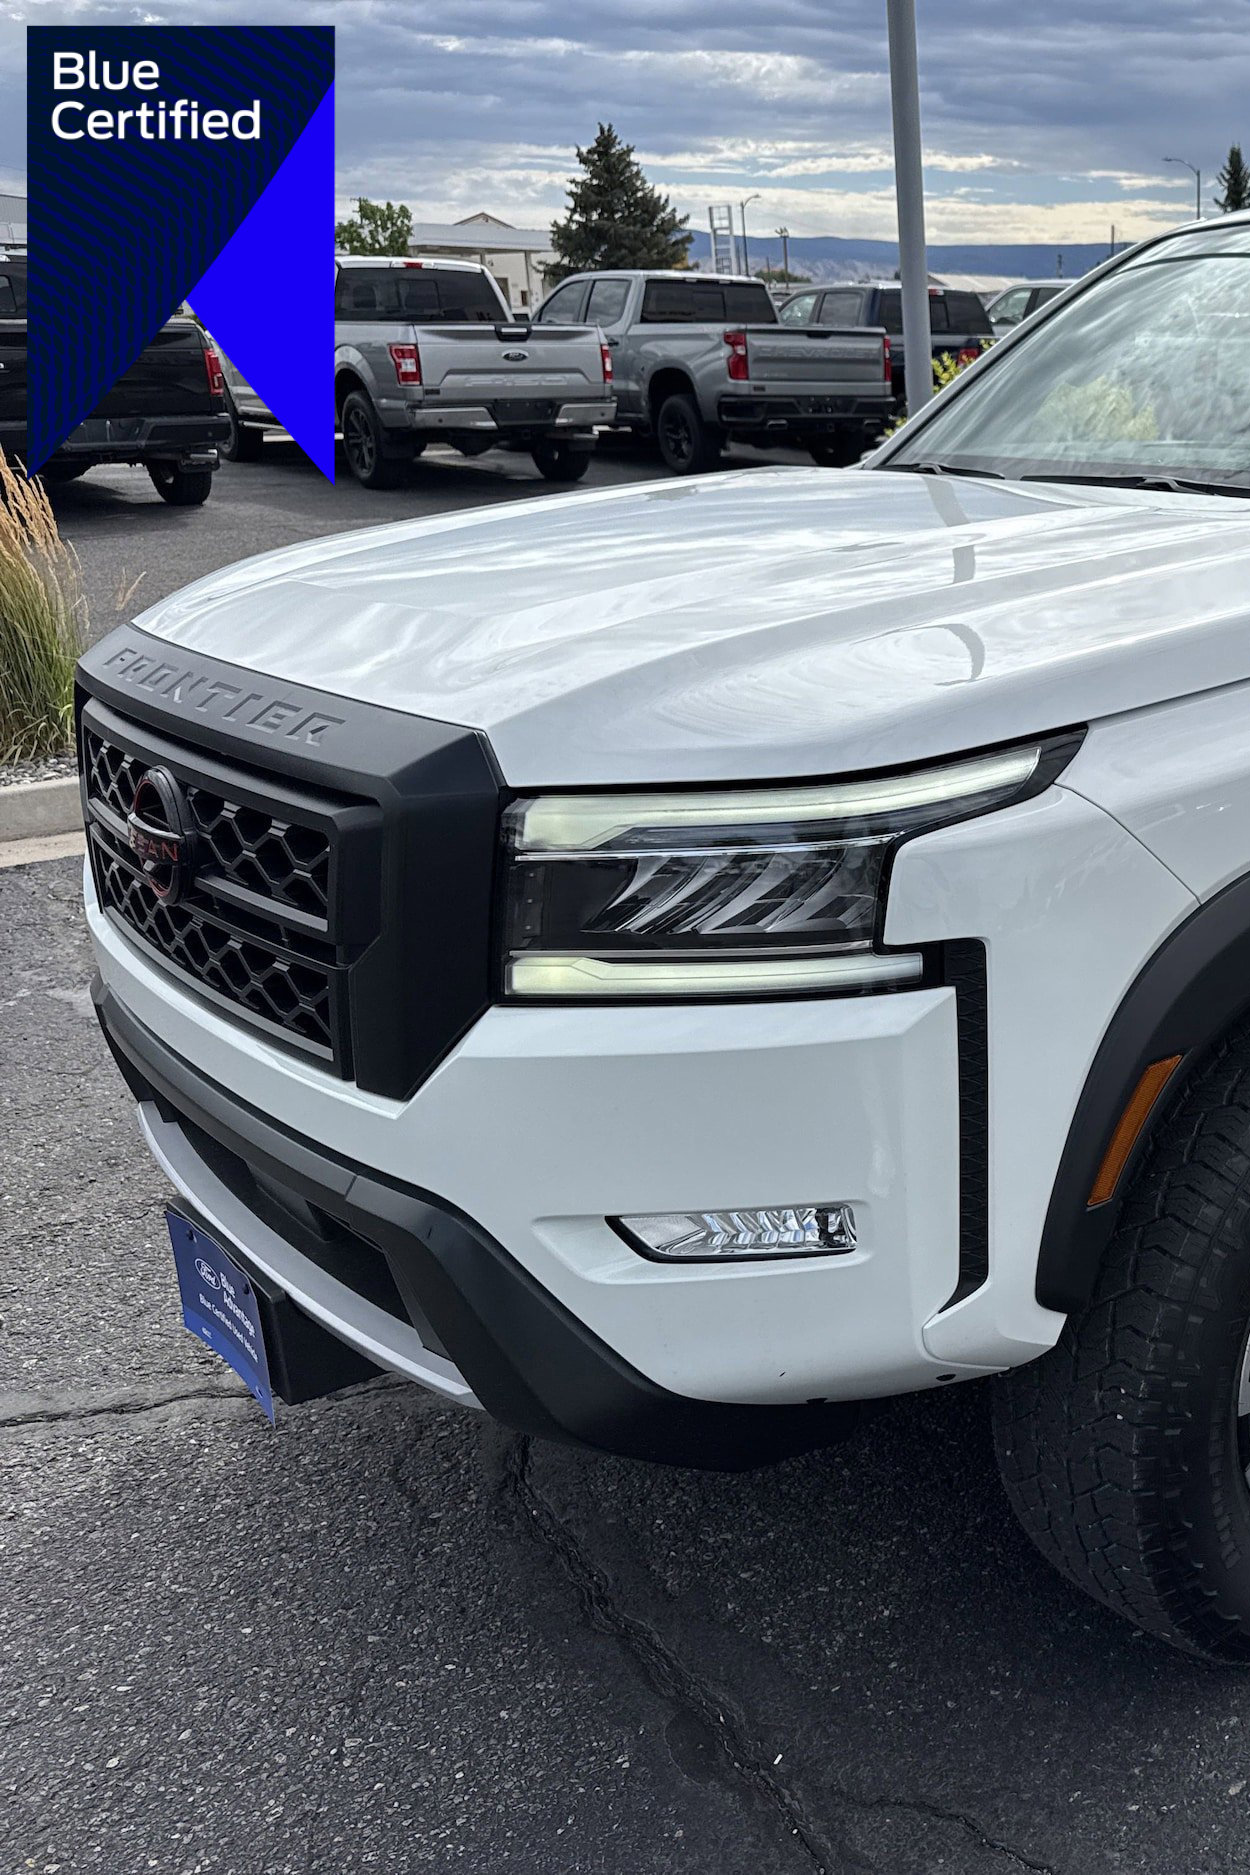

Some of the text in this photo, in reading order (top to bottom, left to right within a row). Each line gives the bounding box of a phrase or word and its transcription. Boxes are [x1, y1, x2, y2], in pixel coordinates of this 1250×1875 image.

[102, 648, 346, 747] FRONTIER
[220, 1271, 235, 1299] Blue
[199, 1293, 212, 1311] Blue
[211, 1303, 232, 1331] Certified
[223, 1290, 256, 1338] Advantage
